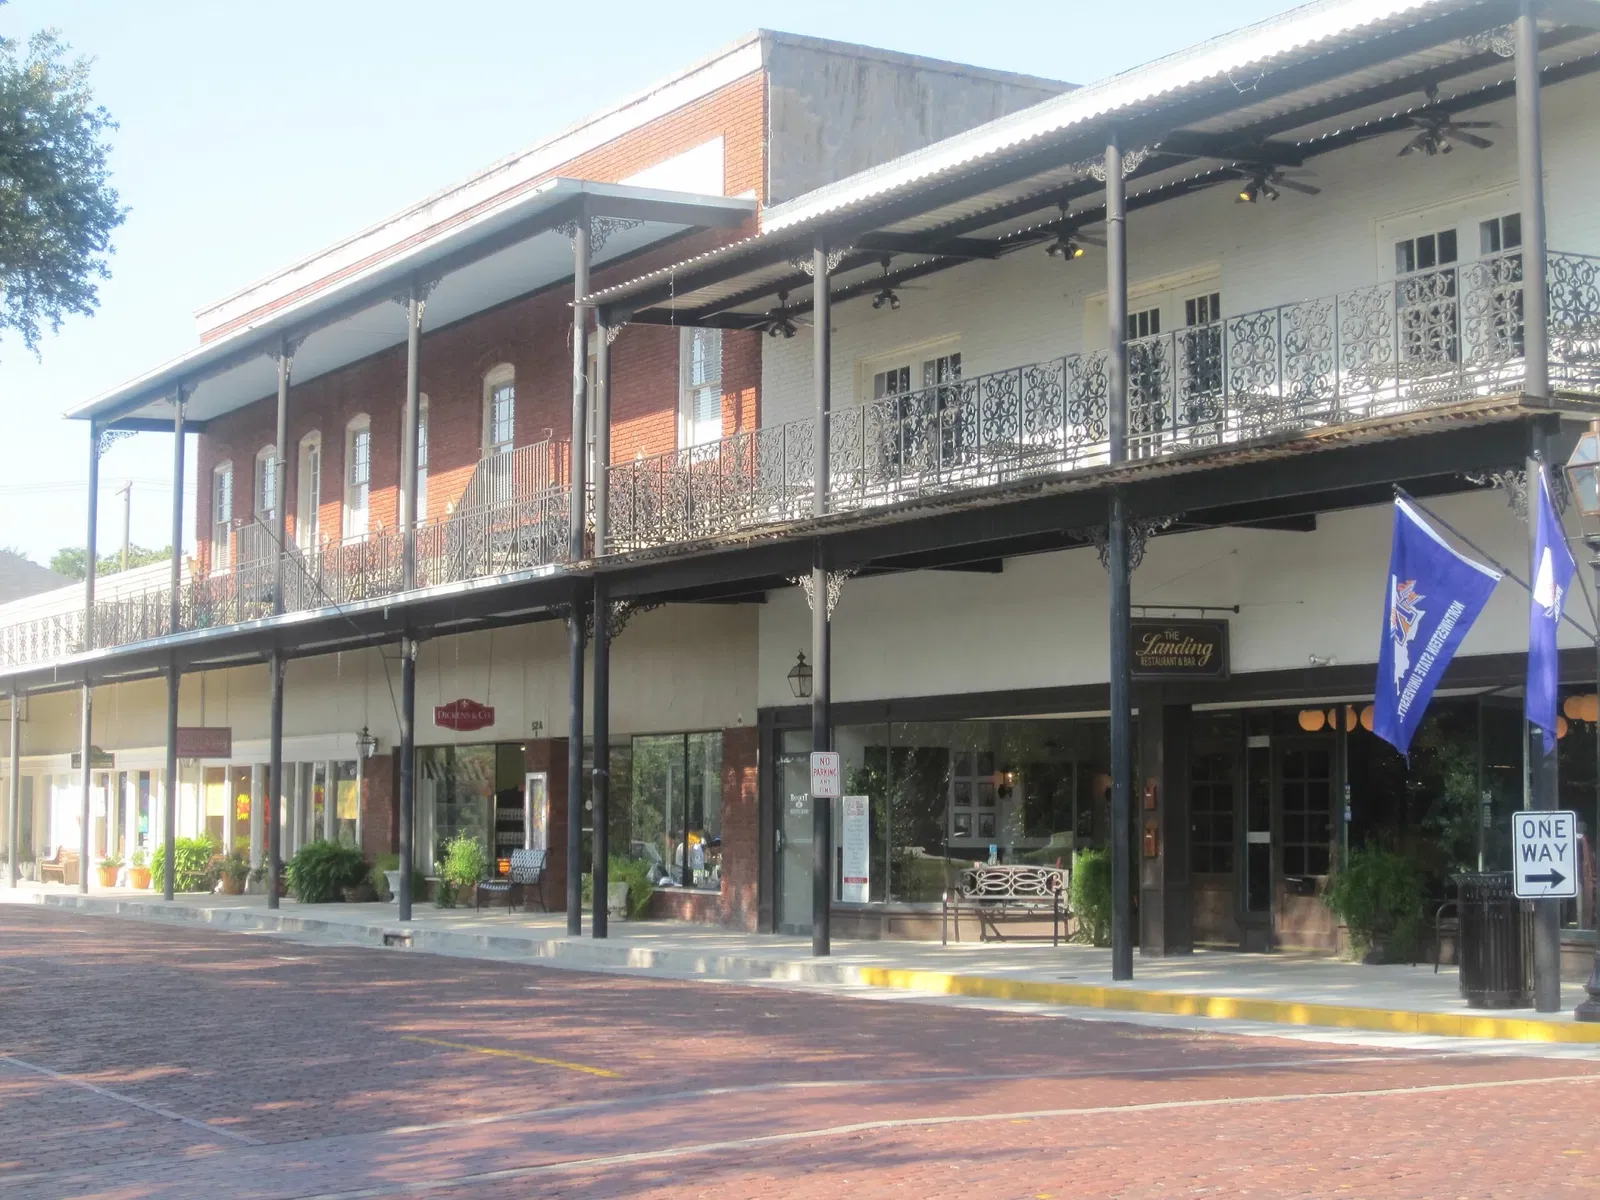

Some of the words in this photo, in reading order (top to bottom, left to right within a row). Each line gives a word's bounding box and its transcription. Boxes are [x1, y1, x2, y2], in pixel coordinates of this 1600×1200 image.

[1164, 631, 1179, 641] THE
[1136, 633, 1213, 667] Landing
[1140, 656, 1177, 667] RESTAURANT
[1178, 656, 1183, 667] &
[1184, 656, 1196, 667] BAR
[820, 757, 831, 766] NO
[813, 768, 837, 777] PARKING
[1522, 820, 1567, 839] ONE
[1521, 843, 1568, 863] WAY
